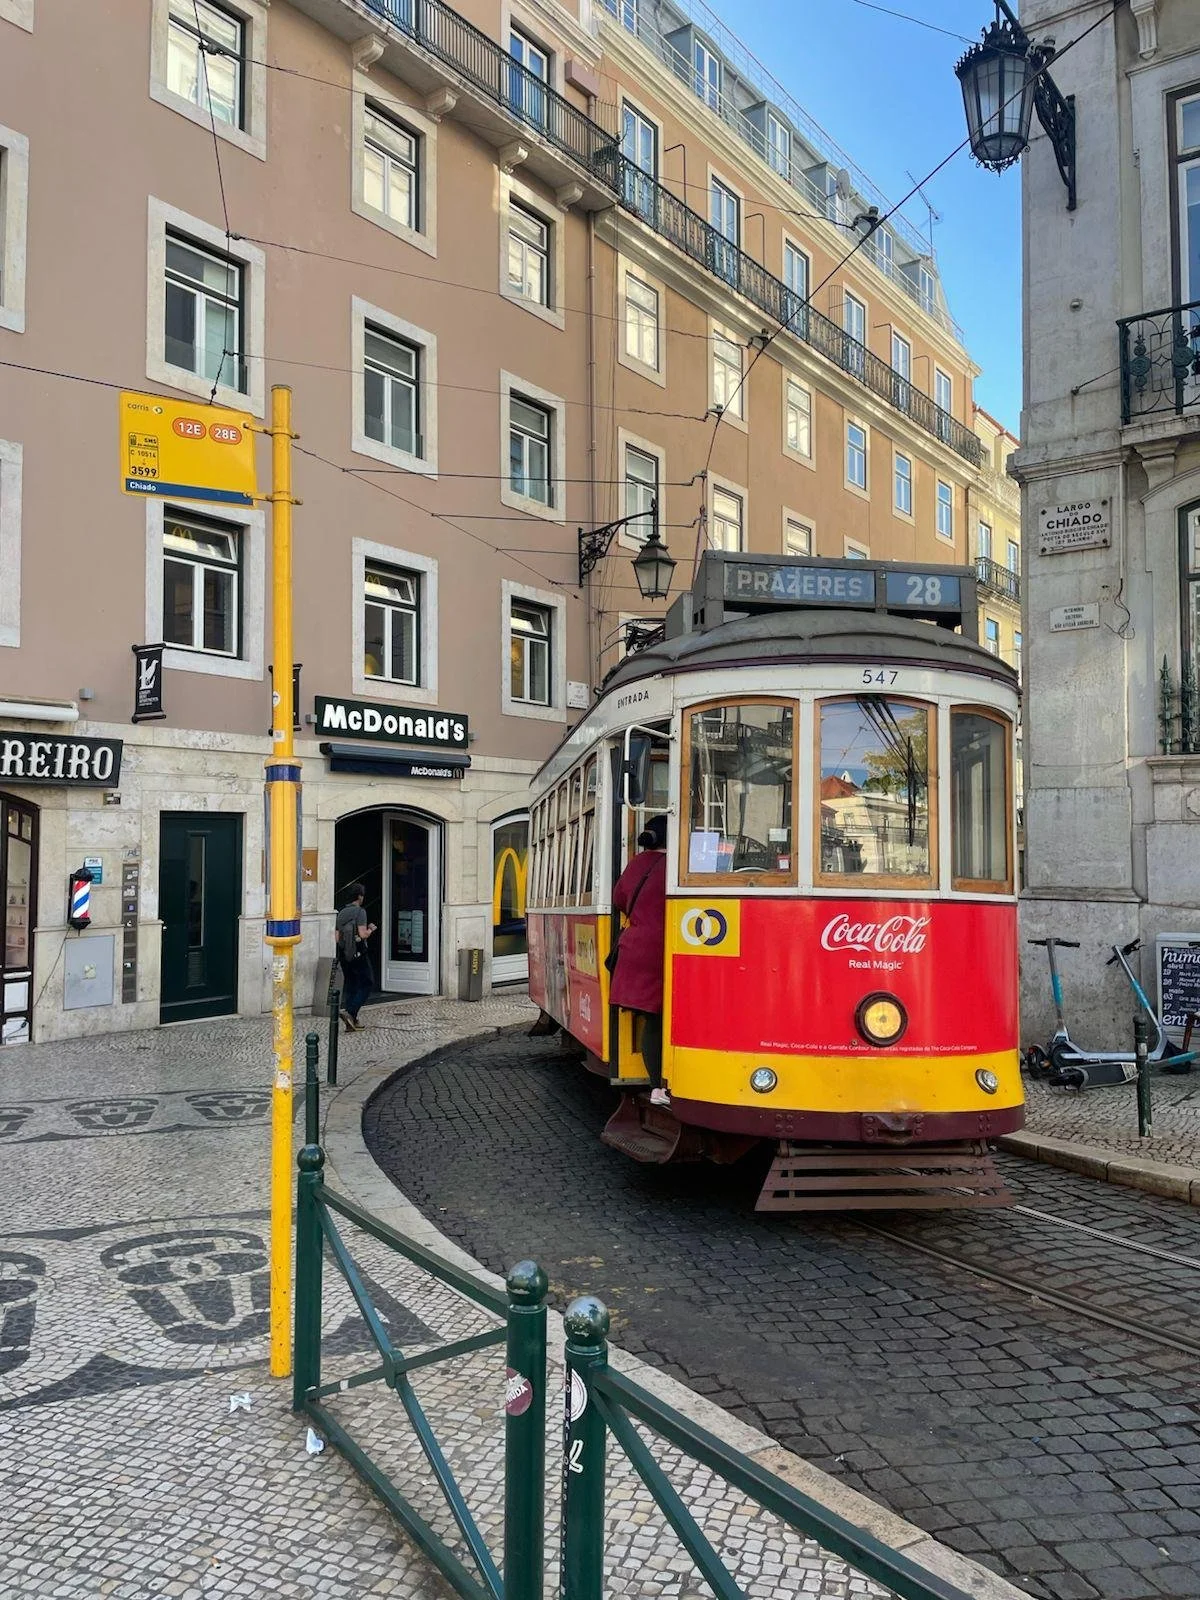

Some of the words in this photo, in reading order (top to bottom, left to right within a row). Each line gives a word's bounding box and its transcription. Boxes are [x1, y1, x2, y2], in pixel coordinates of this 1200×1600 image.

[128, 403, 149, 411] carris
[179, 422, 201, 435] 12E
[214, 428, 237, 440] 28E
[131, 466, 157, 477] 3599
[129, 482, 157, 492] Chiado
[1057, 502, 1091, 513] LARGO
[1046, 513, 1102, 529] CHIADO
[737, 571, 862, 596] PRAZERES
[906, 576, 942, 605] 28
[862, 670, 898, 685] 547
[618, 691, 649, 709] ENTRADA
[323, 704, 465, 741] McDonald's
[0, 740, 114, 780] REIRO
[411, 767, 452, 777] McDonald's
[821, 914, 932, 953] Coca-Cola
[849, 960, 871, 969] Real
[873, 960, 902, 971] Magic
